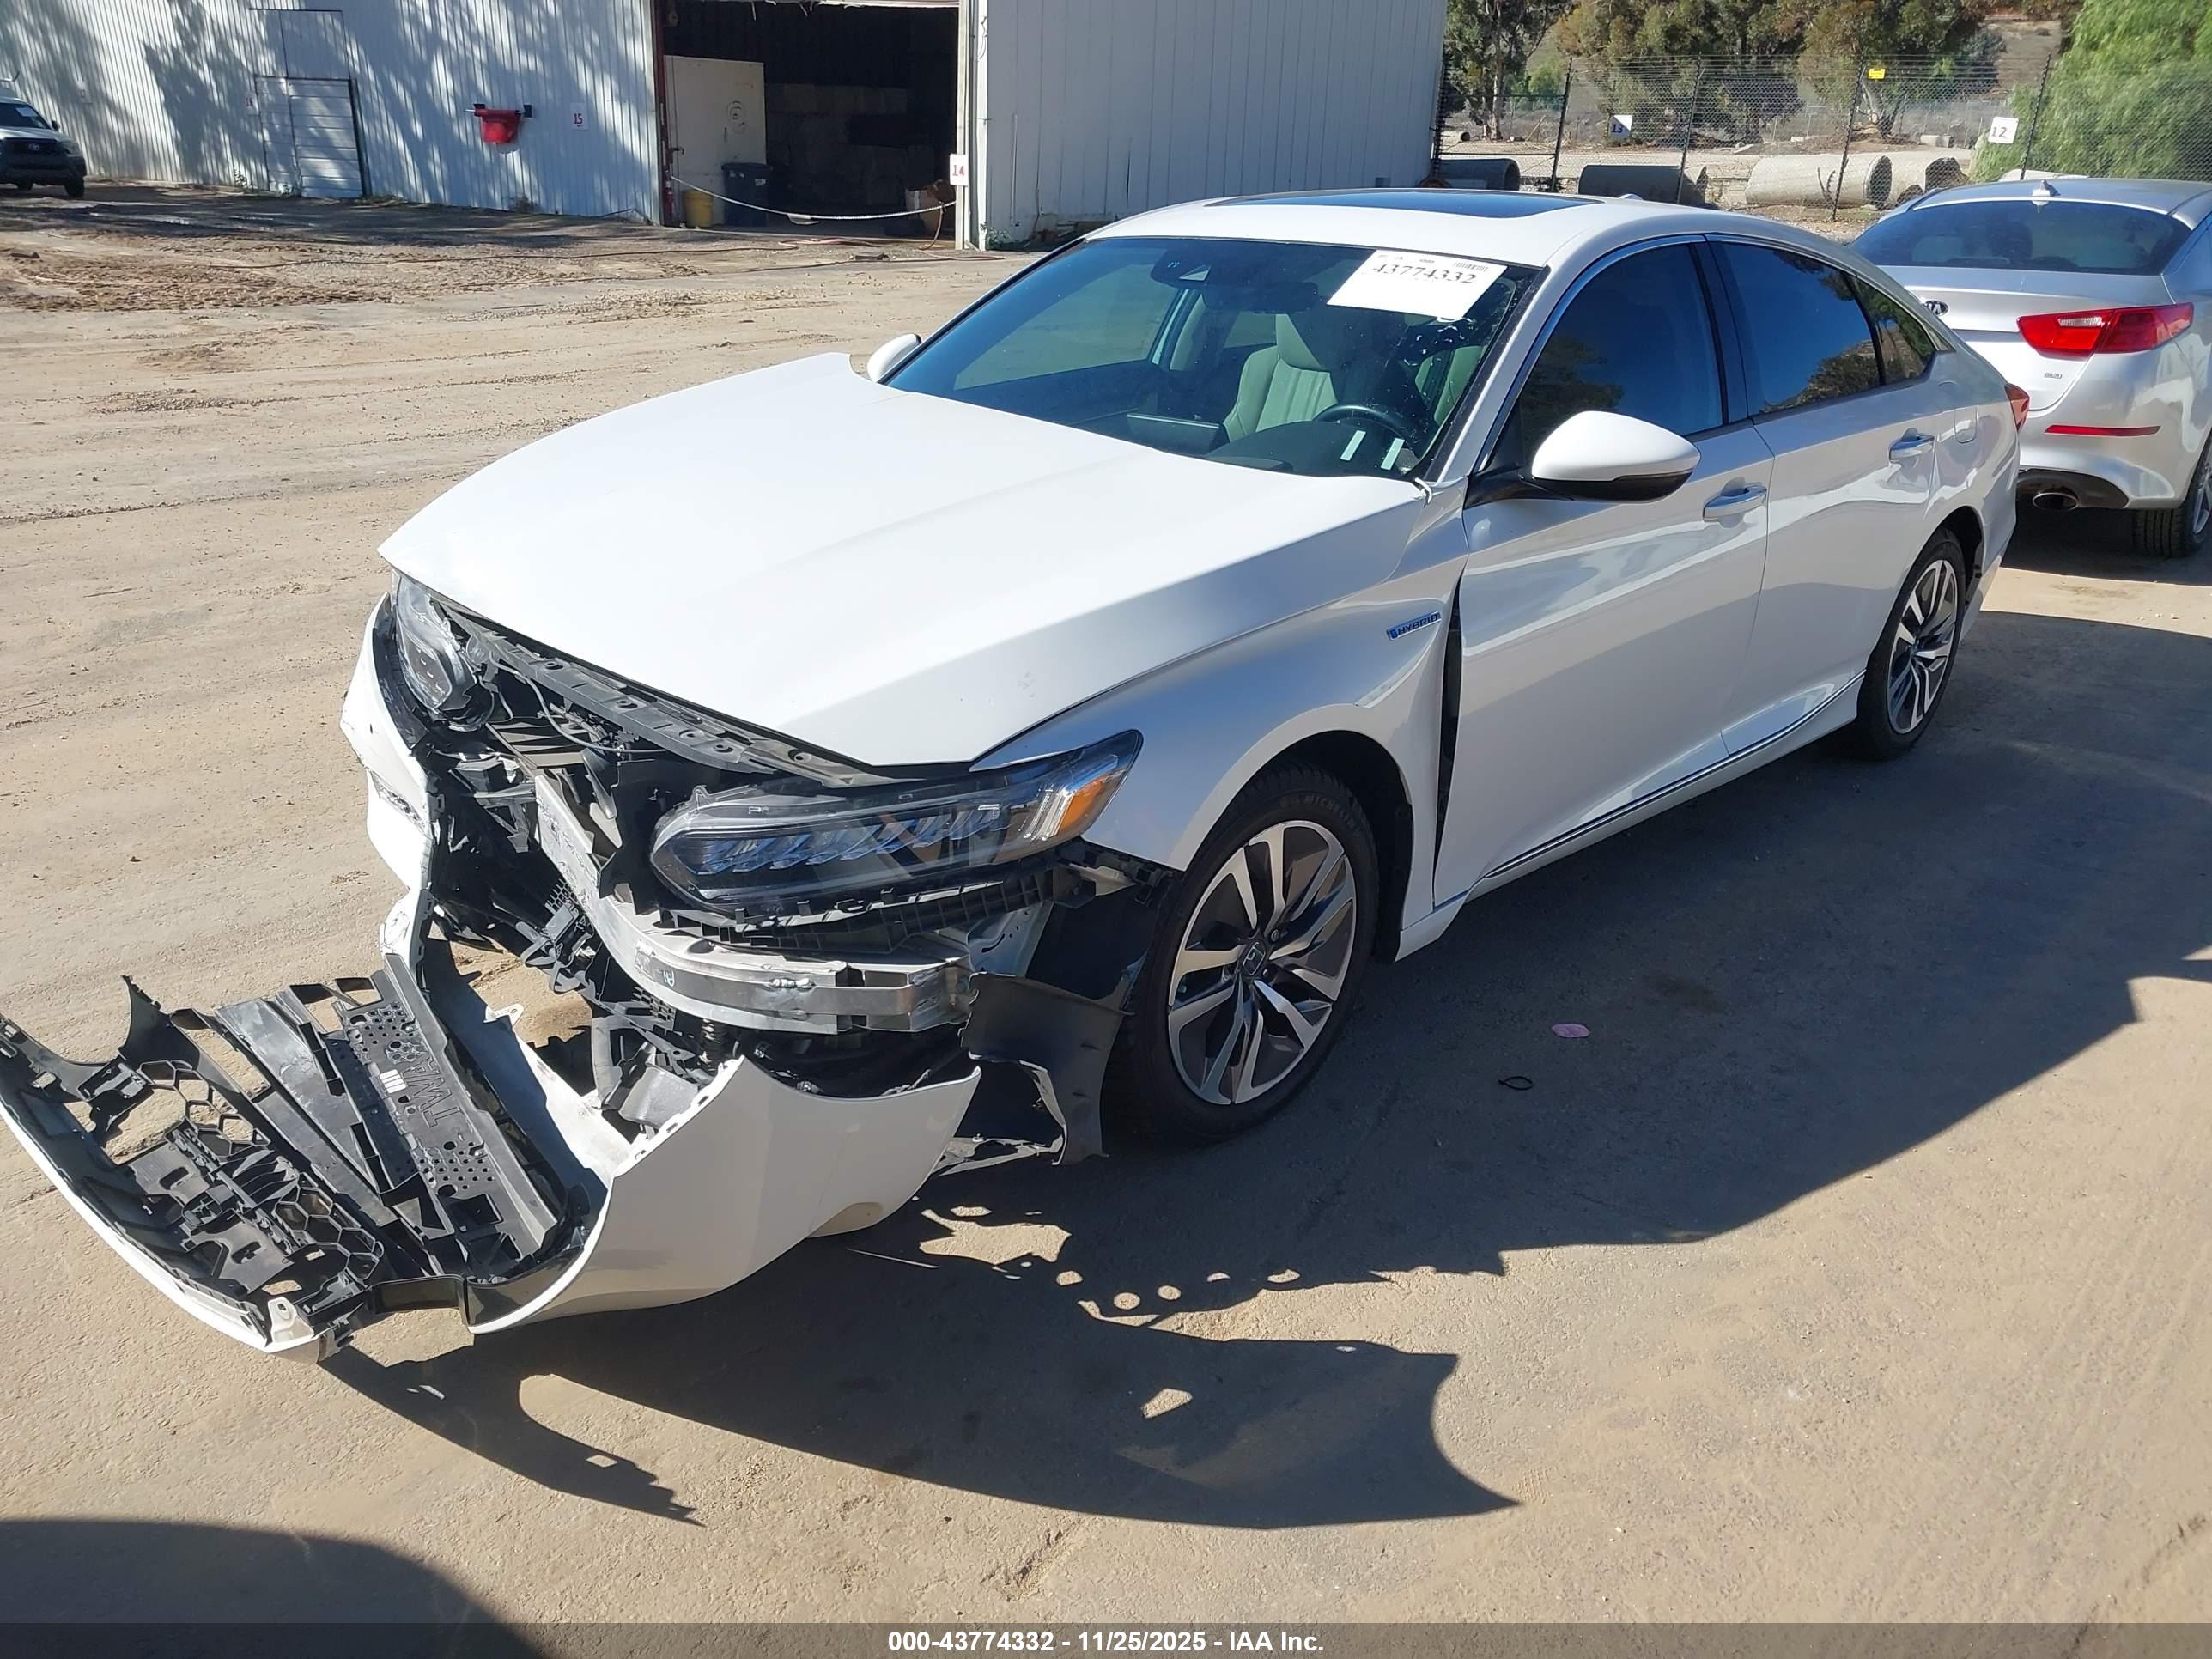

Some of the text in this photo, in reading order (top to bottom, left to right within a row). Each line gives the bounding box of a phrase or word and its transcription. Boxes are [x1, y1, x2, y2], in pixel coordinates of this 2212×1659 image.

[574, 112, 583, 125] 15
[1611, 123, 1623, 133] 13
[1991, 126, 2007, 138] 12
[952, 164, 965, 179] 14
[1373, 263, 1477, 284] 43774332
[1398, 613, 1438, 635] HYBRID
